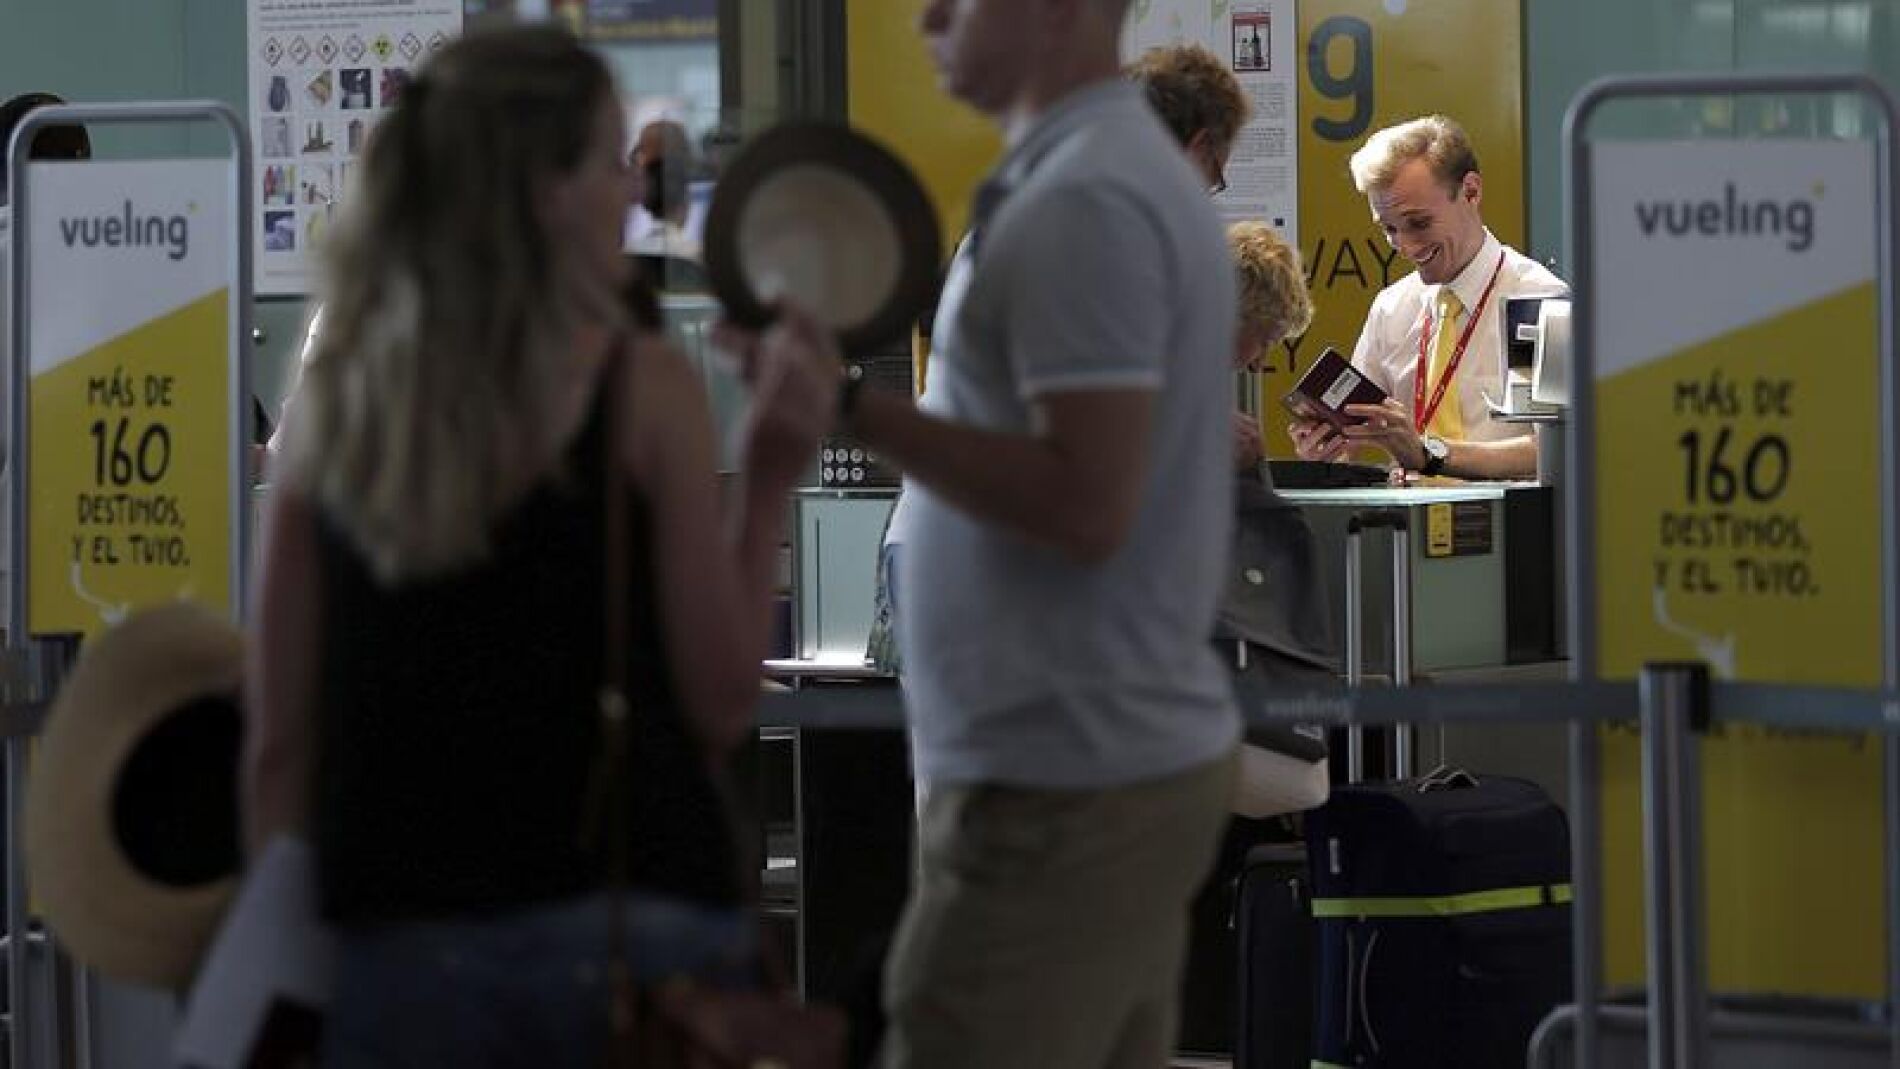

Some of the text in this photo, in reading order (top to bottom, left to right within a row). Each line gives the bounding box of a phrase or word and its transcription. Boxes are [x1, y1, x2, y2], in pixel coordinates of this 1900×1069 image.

[60, 199, 188, 261] vueling
[1634, 180, 1814, 252] vueling
[88, 365, 175, 408] MÁS DE
[1673, 369, 1795, 417] MÁS DE
[90, 416, 172, 487] 160
[1679, 425, 1791, 505] 160
[72, 534, 84, 562] Y
[93, 536, 119, 565] EL
[1653, 560, 1670, 589] Y
[1681, 559, 1720, 594] EL
